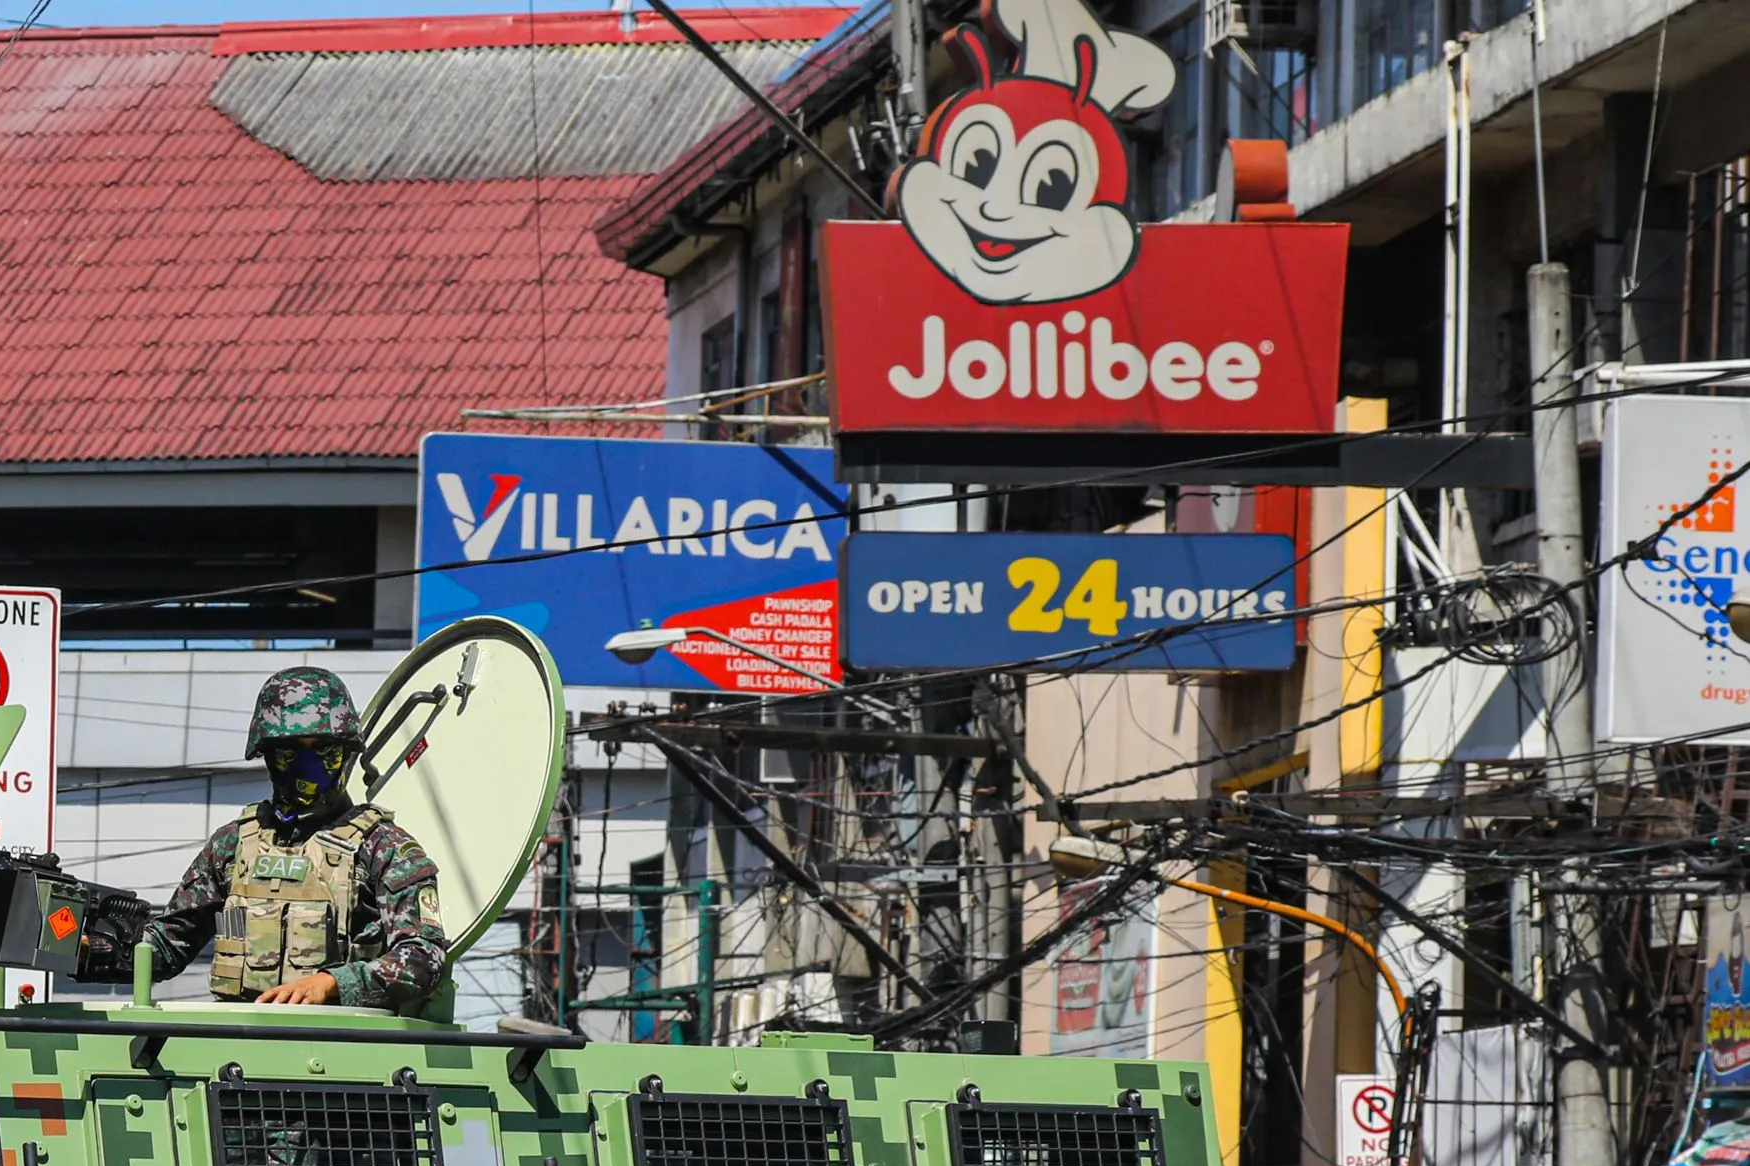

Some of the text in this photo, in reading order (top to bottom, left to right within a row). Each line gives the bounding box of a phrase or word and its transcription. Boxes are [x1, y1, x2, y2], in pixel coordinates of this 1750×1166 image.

[888, 310, 1261, 400] Jollibee
[436, 473, 832, 560] VILLARICA
[1643, 536, 1750, 575] Gen
[764, 597, 833, 613] PAWNSHOP
[867, 557, 1287, 636] OPEN 24 HOURS
[750, 612, 832, 628] CASH PADALA
[729, 627, 833, 644] MONEY CHANGER
[800, 645, 832, 659] SALE
[736, 673, 772, 688] BILLS
[256, 856, 306, 877] SAF
